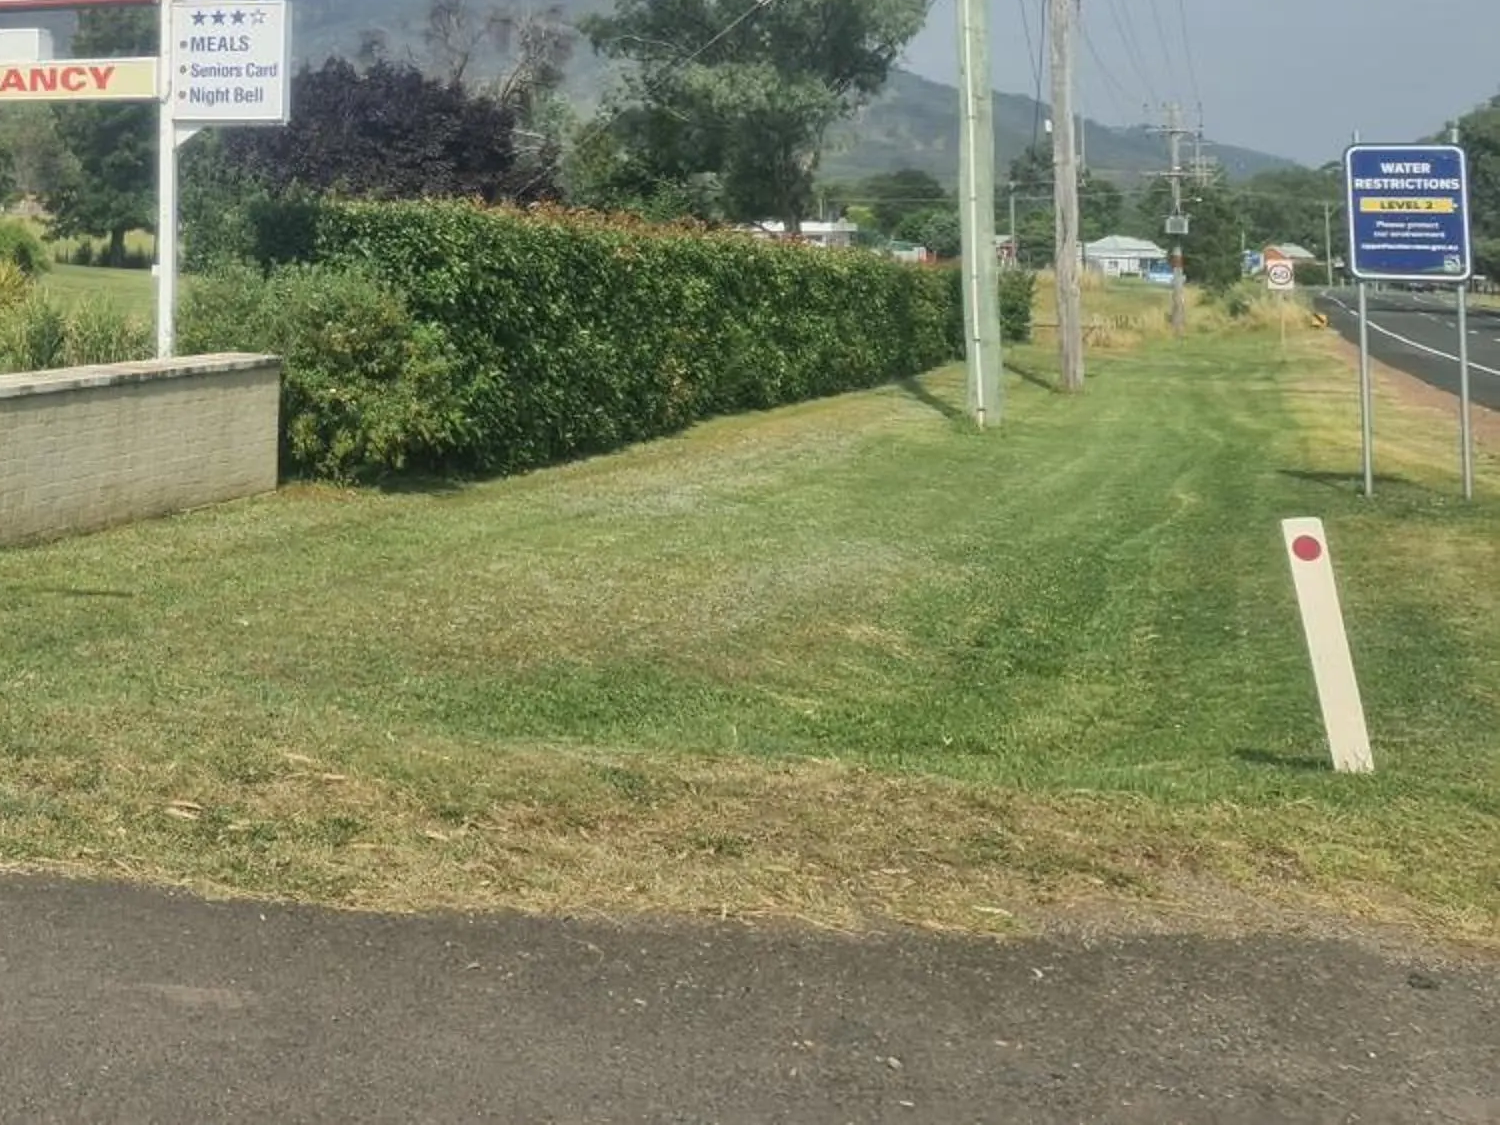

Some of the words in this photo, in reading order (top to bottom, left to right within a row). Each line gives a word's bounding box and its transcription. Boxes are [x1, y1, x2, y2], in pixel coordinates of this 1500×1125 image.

[190, 35, 250, 52] MEALS
[191, 62, 242, 77] Seniors
[245, 62, 277, 77] Card
[189, 87, 229, 107] Night
[234, 86, 263, 103] Bell
[1380, 162, 1431, 174] WATER
[1354, 178, 1460, 190] RESTRICTIONS
[1380, 200, 1420, 210] LEVEL
